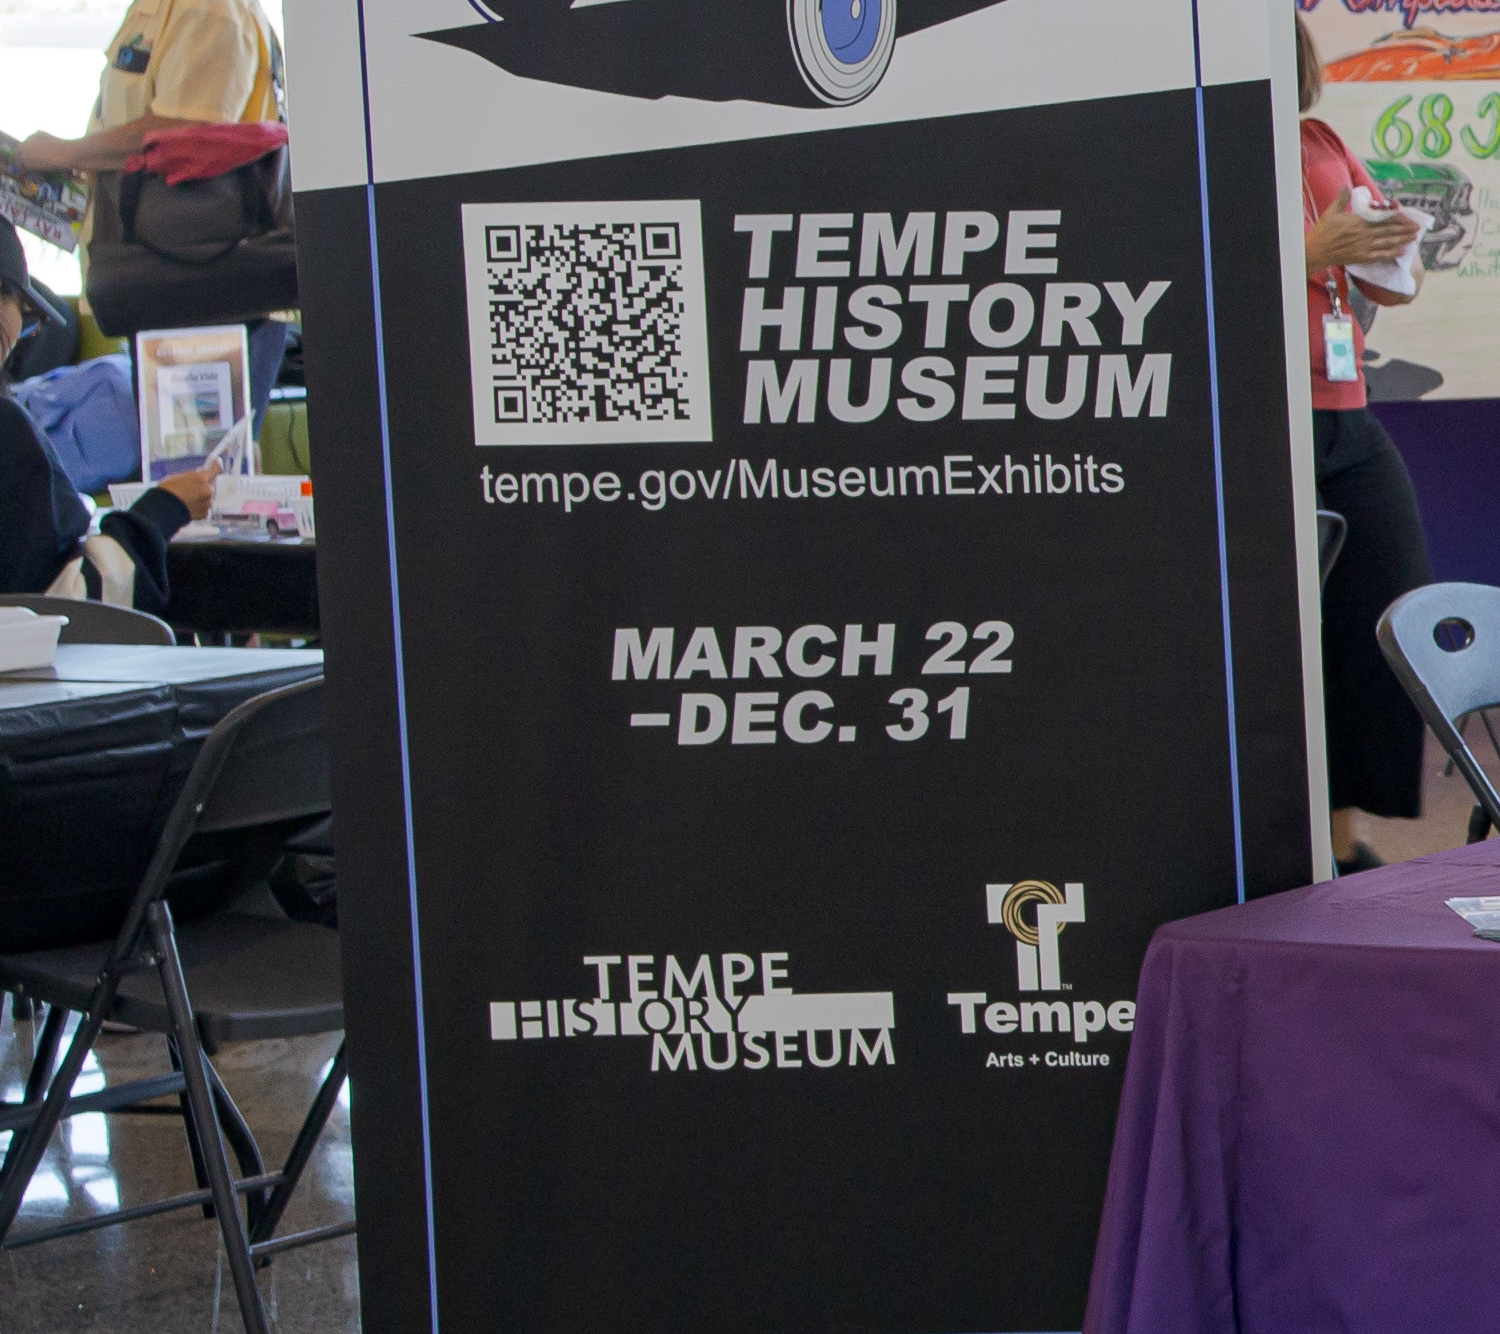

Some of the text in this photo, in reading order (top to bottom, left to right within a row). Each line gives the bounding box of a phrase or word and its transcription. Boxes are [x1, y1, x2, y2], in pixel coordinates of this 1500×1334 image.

[1371, 93, 1453, 160] 68
[733, 210, 1062, 278] TEMPE
[739, 280, 1172, 351] HISTORY
[743, 353, 1172, 424] MUSEUM
[480, 455, 1125, 512] tempe.gov/MuseumExhibits
[611, 621, 1016, 680] MARCH 22
[886, 687, 971, 740] 31
[583, 952, 792, 1001] TEMPE
[517, 995, 750, 1039] HISTORY
[947, 991, 1136, 1042] Tempe
[649, 1028, 895, 1071] MUSEUM
[985, 1050, 1025, 1067] Arts
[1044, 1050, 1110, 1067] Culture
